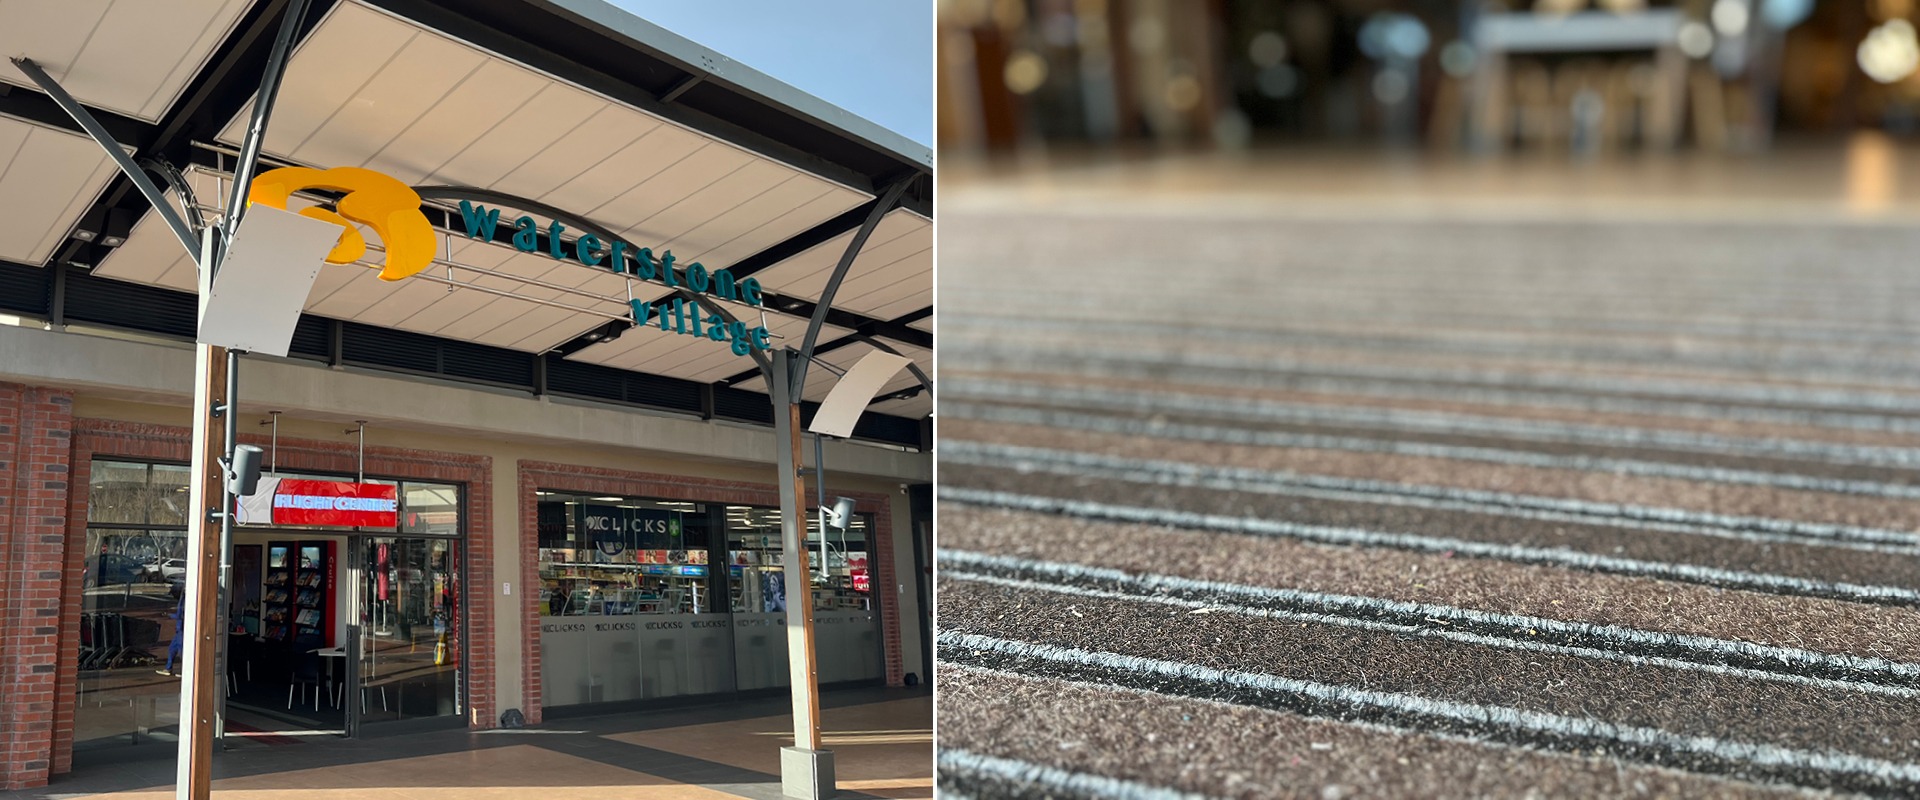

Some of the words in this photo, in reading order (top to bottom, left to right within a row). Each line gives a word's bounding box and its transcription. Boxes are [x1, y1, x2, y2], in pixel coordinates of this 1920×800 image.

[459, 199, 763, 306] waterstone
[630, 297, 771, 356] village
[276, 494, 334, 509] FLIGHT
[334, 496, 397, 512] CENTRE
[599, 516, 667, 534] CLICKS
